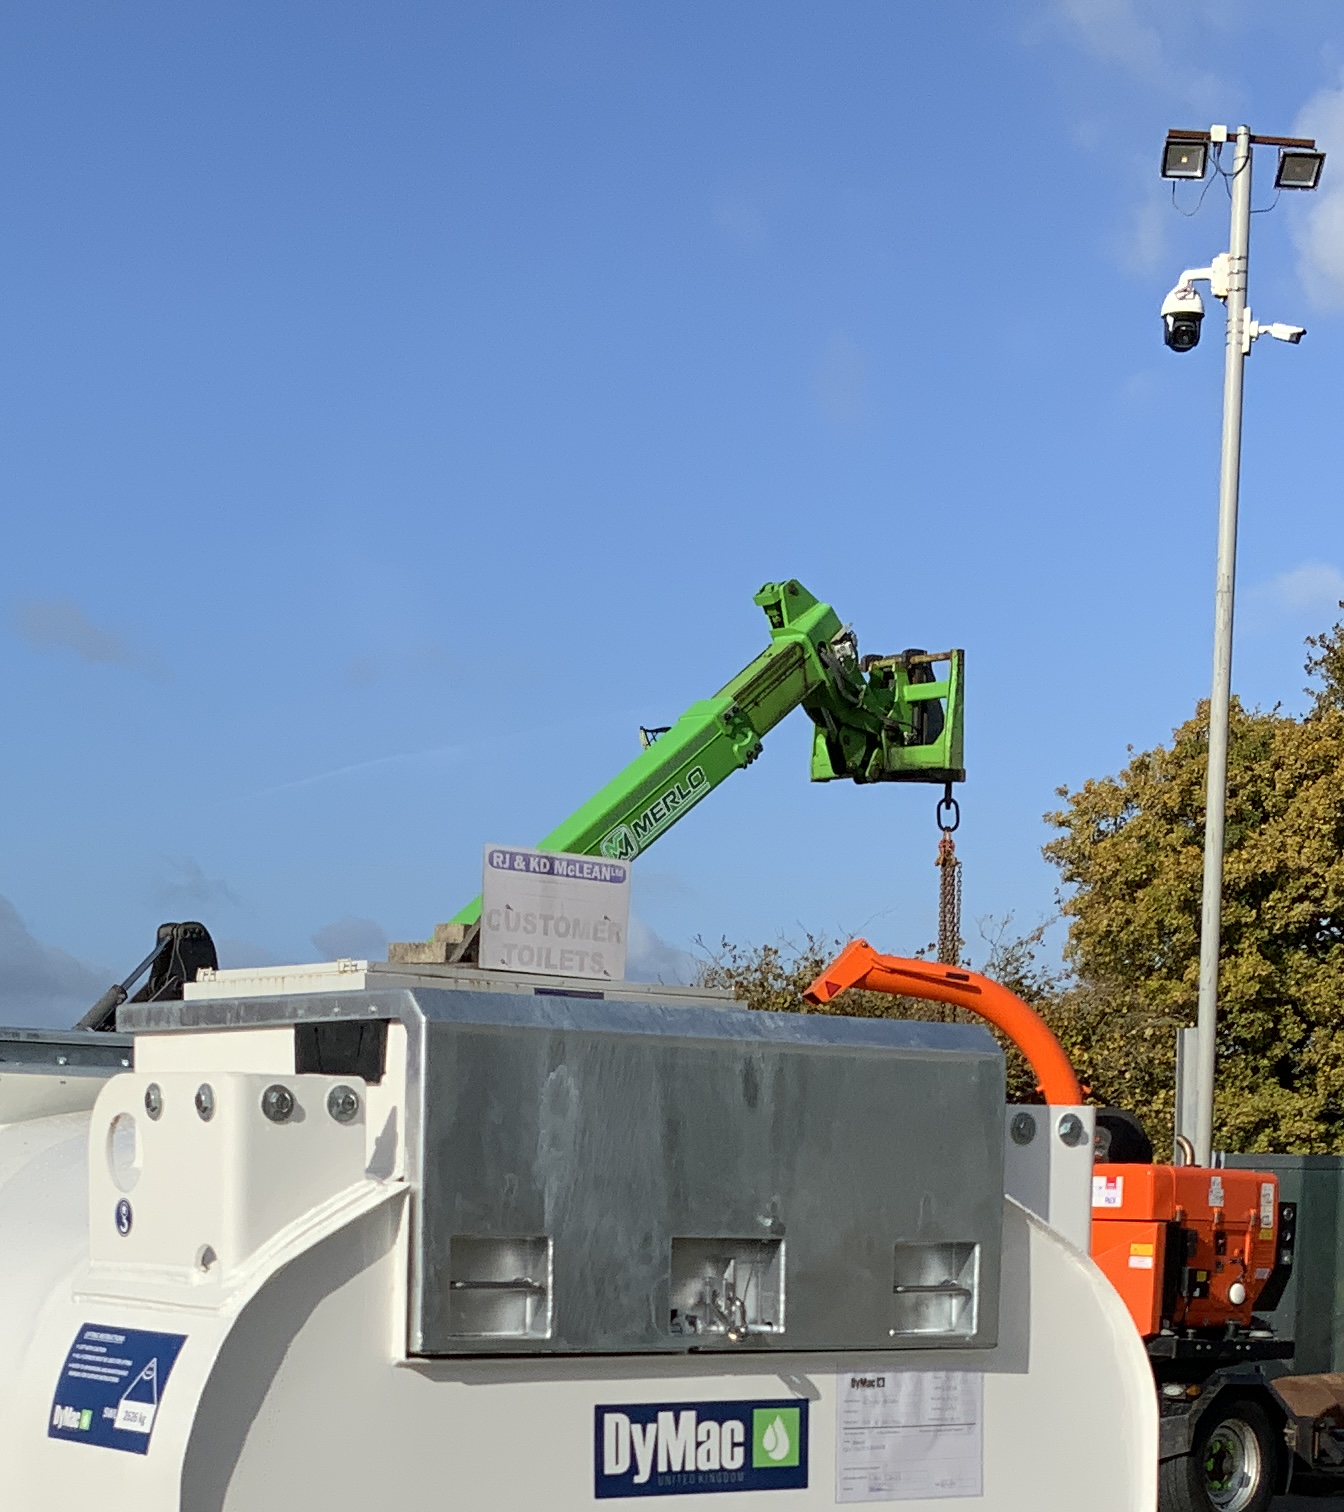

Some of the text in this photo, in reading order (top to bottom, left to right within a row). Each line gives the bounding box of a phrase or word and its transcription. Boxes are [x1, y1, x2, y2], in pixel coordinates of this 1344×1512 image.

[631, 766, 707, 839] MERLO
[492, 852, 510, 869] RJ
[514, 855, 526, 871] &
[529, 857, 551, 874] KD
[554, 860, 611, 881] McLEAN
[486, 908, 623, 945] CUSTOMER
[502, 943, 605, 975] TOILETS
[602, 1409, 745, 1484] DyMac
[657, 1471, 745, 1487] UNITED KINGDOM
